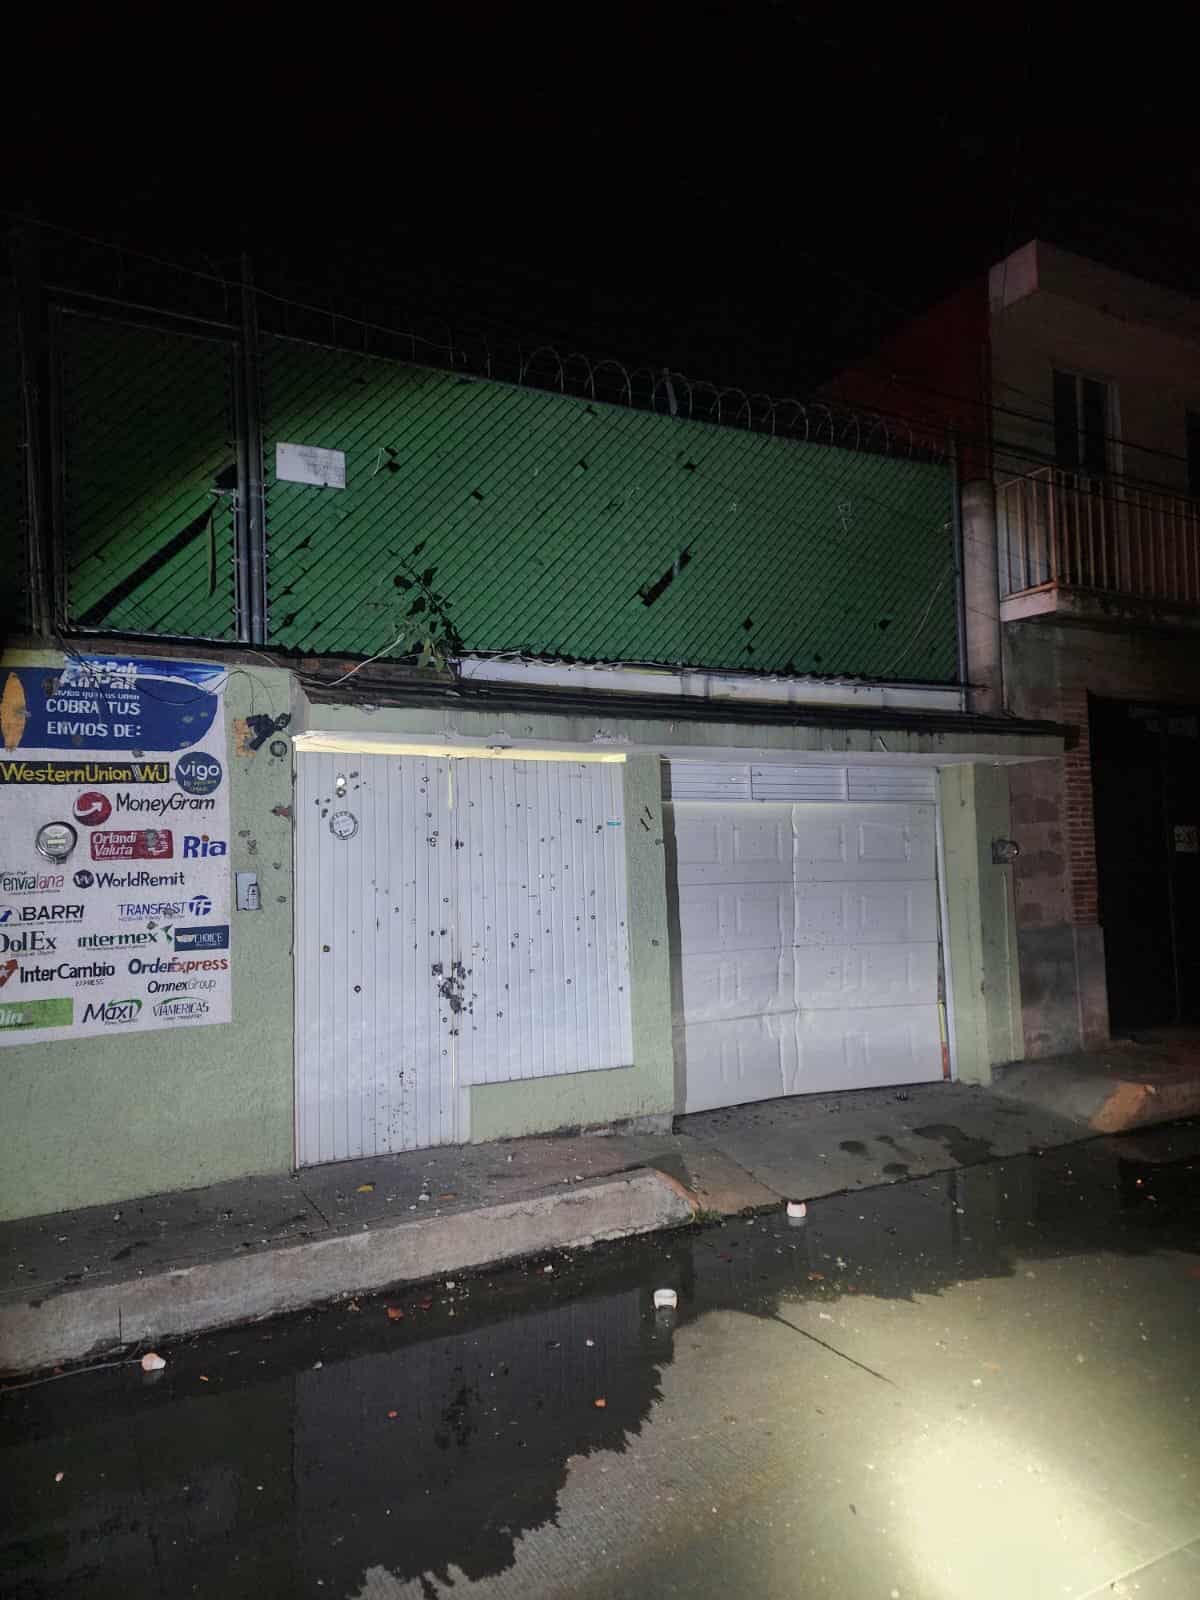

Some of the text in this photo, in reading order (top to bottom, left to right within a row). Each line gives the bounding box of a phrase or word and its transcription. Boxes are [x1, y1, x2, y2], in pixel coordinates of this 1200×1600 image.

[46, 698, 142, 716] COBRA TUS
[47, 721, 142, 738] ENVIOS DE:
[178, 761, 220, 781] vigo
[116, 793, 215, 816] MoneyGram
[93, 831, 137, 845] Orlandi
[183, 834, 226, 858] Ria
[93, 844, 133, 857] Valuta
[96, 871, 185, 889] WorldRemit
[22, 904, 85, 921] BARRI
[118, 902, 187, 916] TRANSFAST
[78, 931, 158, 949] intermex
[20, 961, 115, 984] InterCambio
